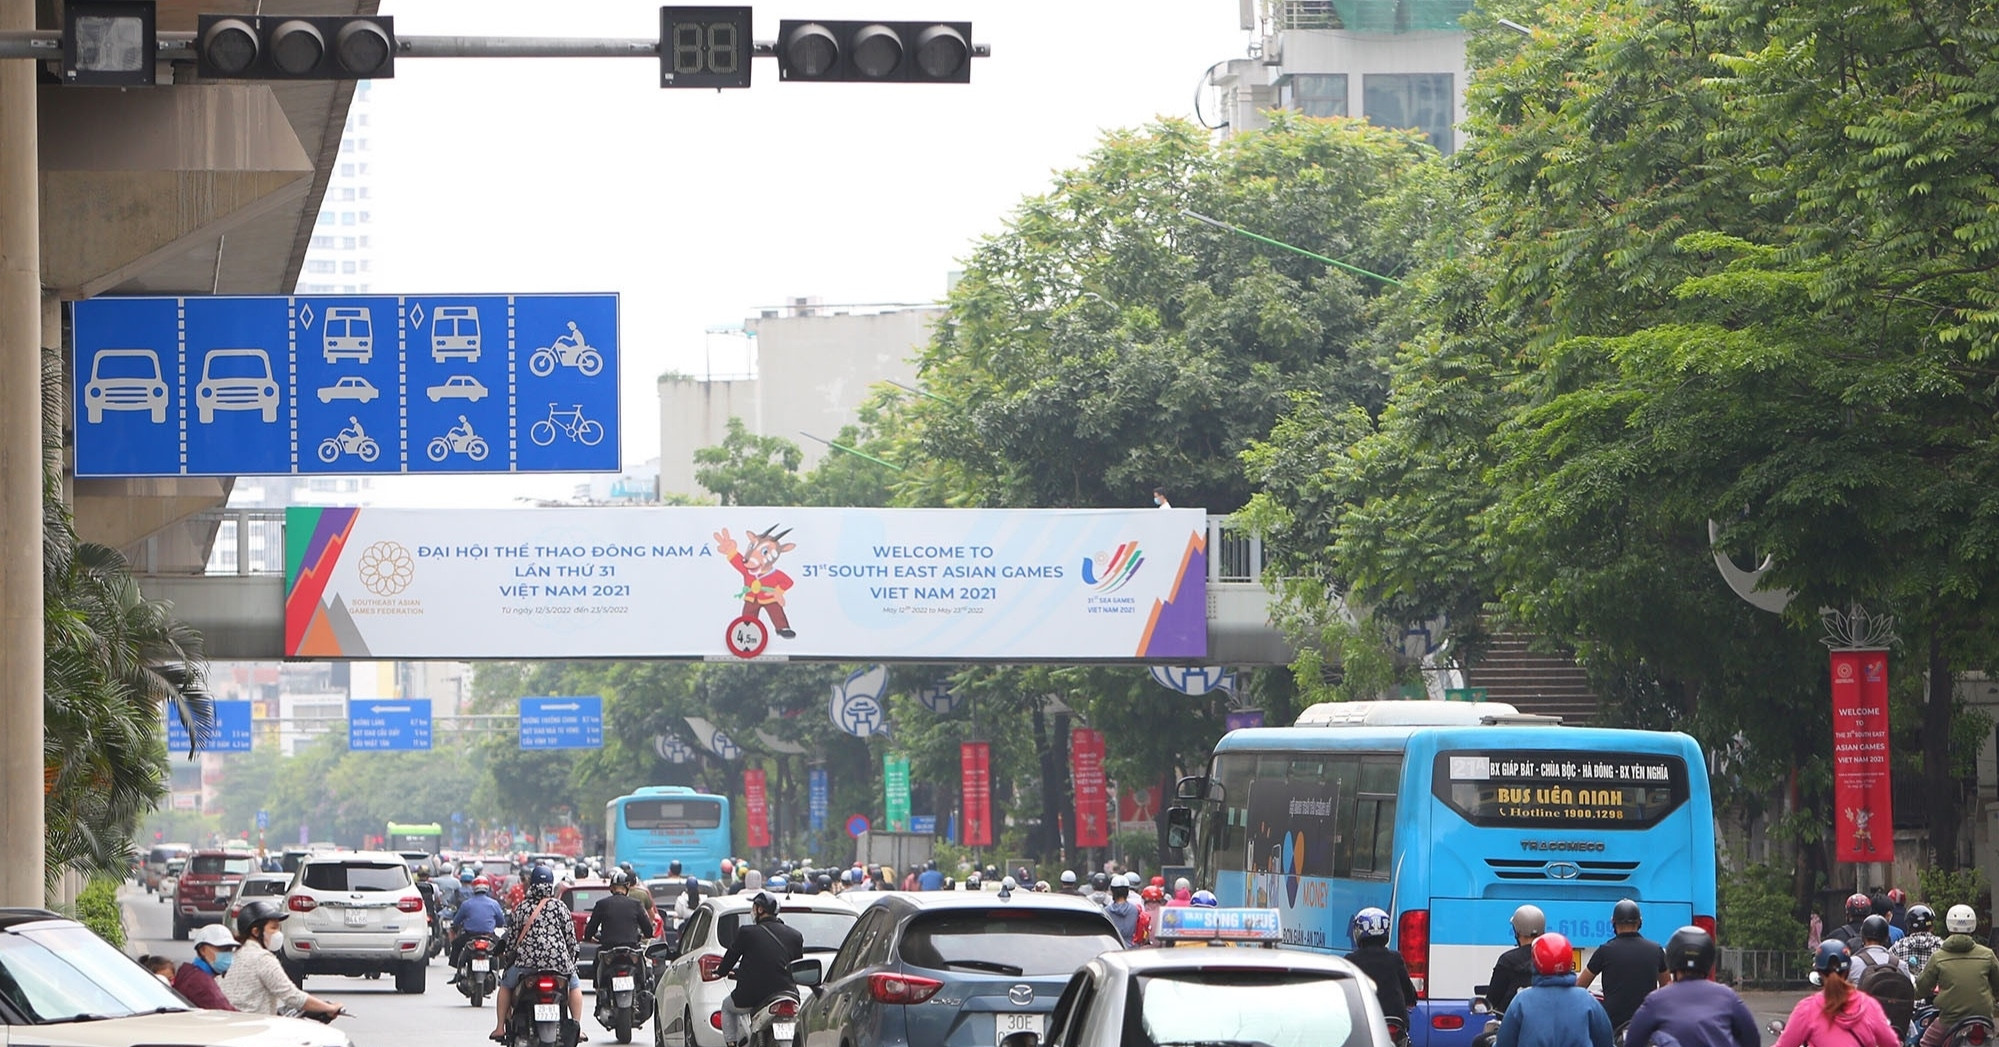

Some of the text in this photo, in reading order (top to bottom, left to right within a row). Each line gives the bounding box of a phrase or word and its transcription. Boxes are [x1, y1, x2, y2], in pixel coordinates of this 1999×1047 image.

[417, 546, 449, 560] ĐẠI
[456, 543, 488, 560] HỘI
[534, 546, 586, 558] THAO
[591, 543, 646, 558] ĐÔNG
[652, 546, 693, 557] NAM
[699, 543, 712, 557] Á
[872, 546, 994, 559] WELCOME TO
[556, 563, 595, 577] THỨ
[599, 566, 615, 577] 31
[894, 565, 938, 578] EAST
[942, 565, 996, 578] ASIAN
[1001, 565, 1064, 579] GAMES
[499, 583, 630, 600] VIỆT NAM 2021
[870, 587, 996, 600] VIET NAM 2021
[349, 607, 424, 615] GAMES FEDERATION
[590, 606, 629, 614] 23/5/2022
[1838, 707, 1880, 716] WELCOME
[1869, 755, 1884, 763] 2021
[1490, 762, 1500, 776] BX
[1501, 760, 1519, 777] GIÁP
[1520, 760, 1534, 777] BÁT
[1540, 760, 1560, 777] CHÙA
[1561, 761, 1576, 780] BỘC
[1582, 761, 1593, 778] HÀ
[1593, 762, 1614, 779] ĐÔNG
[1620, 765, 1630, 779] BX
[1631, 763, 1645, 780] YÊN
[1646, 763, 1669, 780] NGHĨA
[1498, 785, 1622, 806] BUS LIÊN NINH
[1510, 807, 1624, 819] Hotline 1900.1298
[1520, 840, 1605, 852] TRACOMECO
[1303, 880, 1329, 909] MONEY
[1007, 1014, 1033, 1030] 30E
